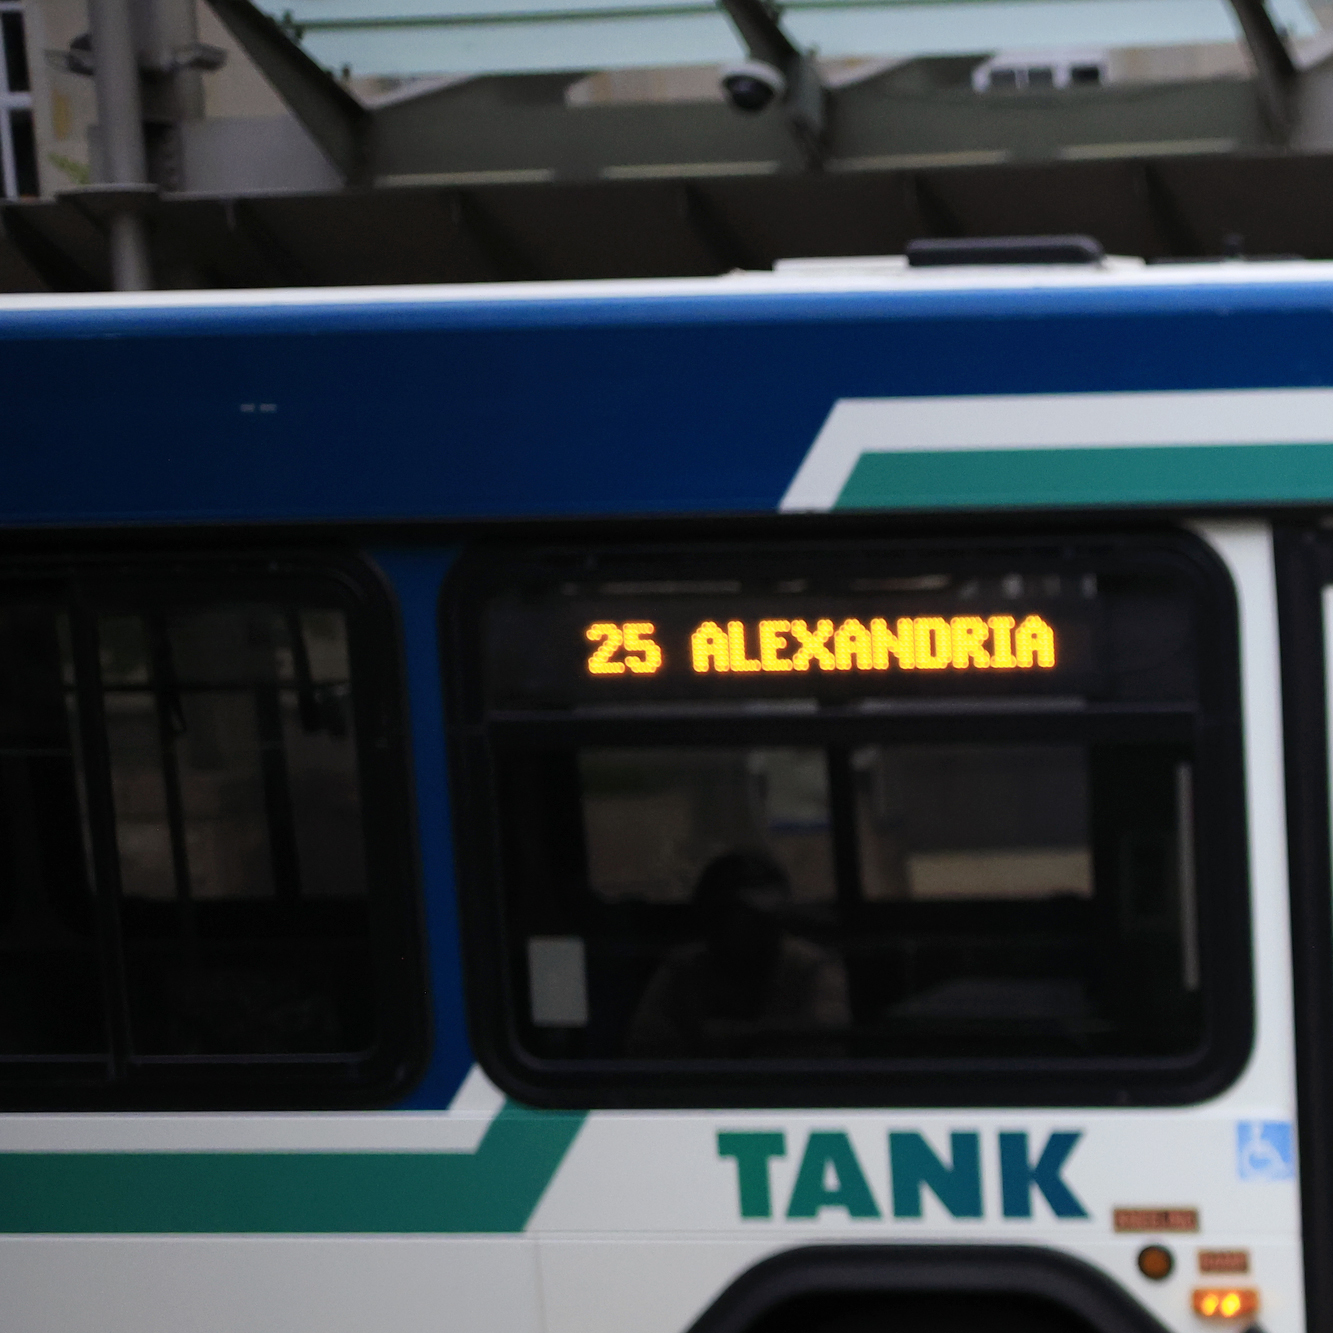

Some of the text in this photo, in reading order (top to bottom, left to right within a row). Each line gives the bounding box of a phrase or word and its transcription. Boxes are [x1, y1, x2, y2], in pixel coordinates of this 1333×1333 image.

[586, 616, 1056, 674] 25 ALEXANDRIA
[716, 1130, 1092, 1219] TANK
